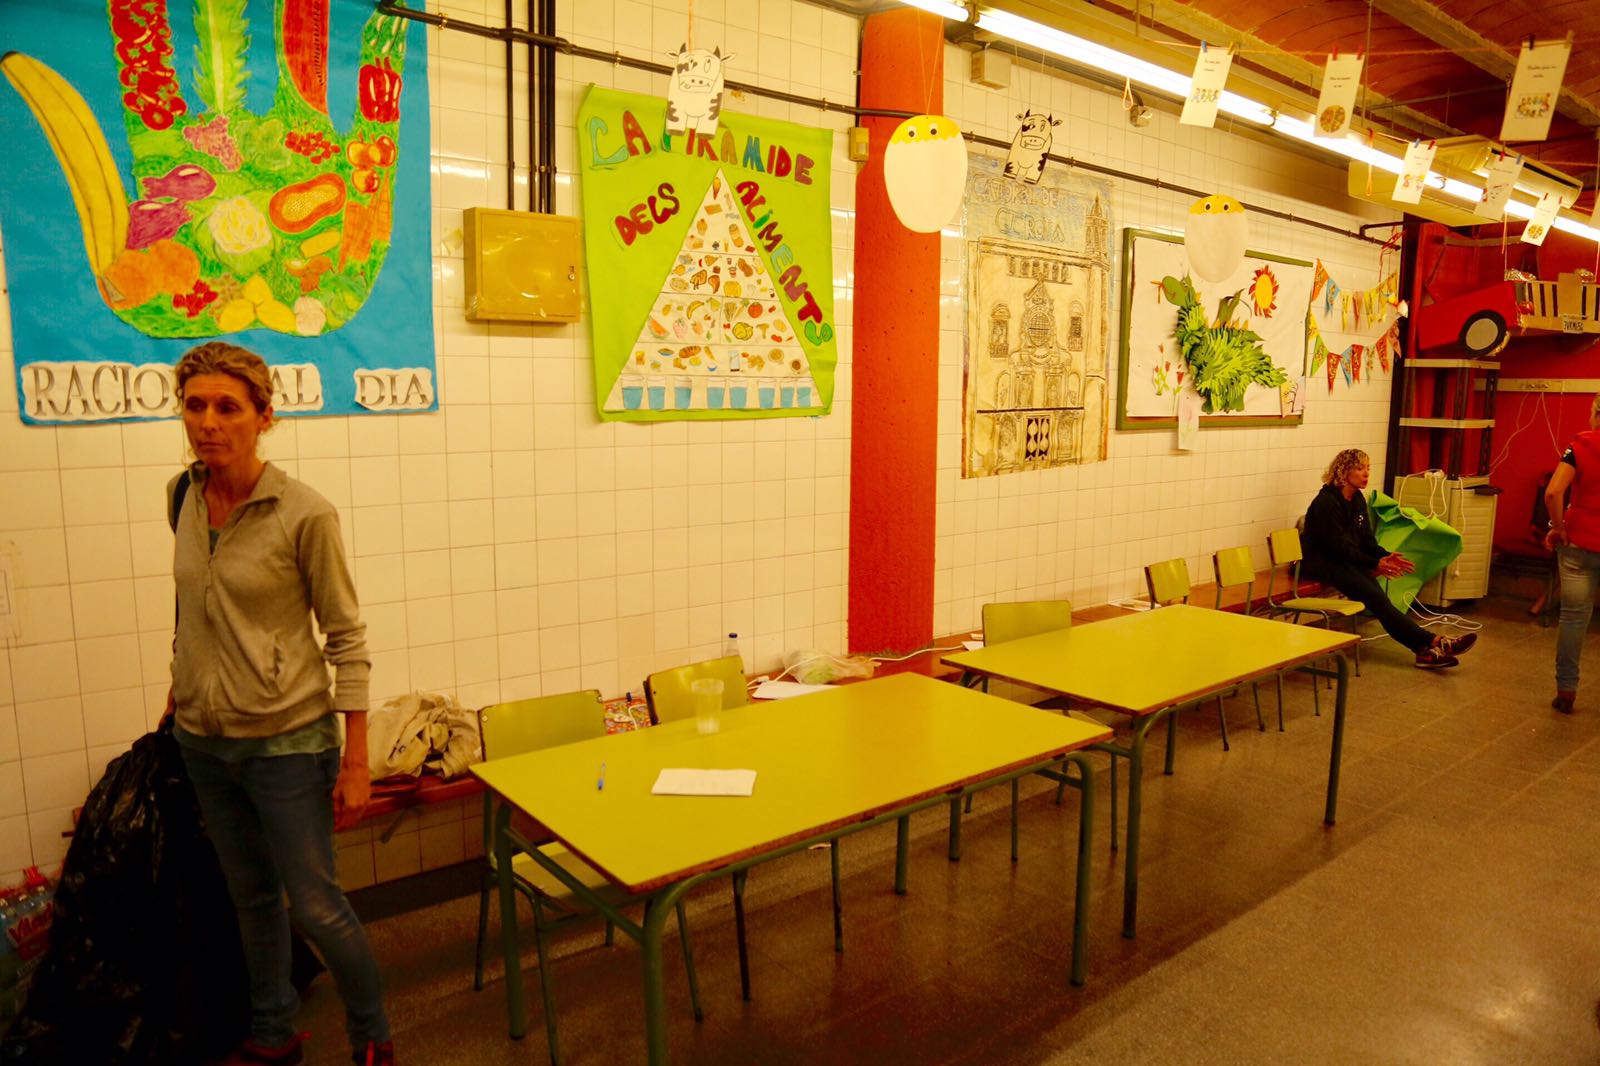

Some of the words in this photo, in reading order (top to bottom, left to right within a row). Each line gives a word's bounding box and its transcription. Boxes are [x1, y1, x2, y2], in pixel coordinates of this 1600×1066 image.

[588, 109, 652, 168] LA
[614, 182, 681, 246] DELS
[28, 364, 184, 416] RACIO
[356, 373, 431, 407] DIA
